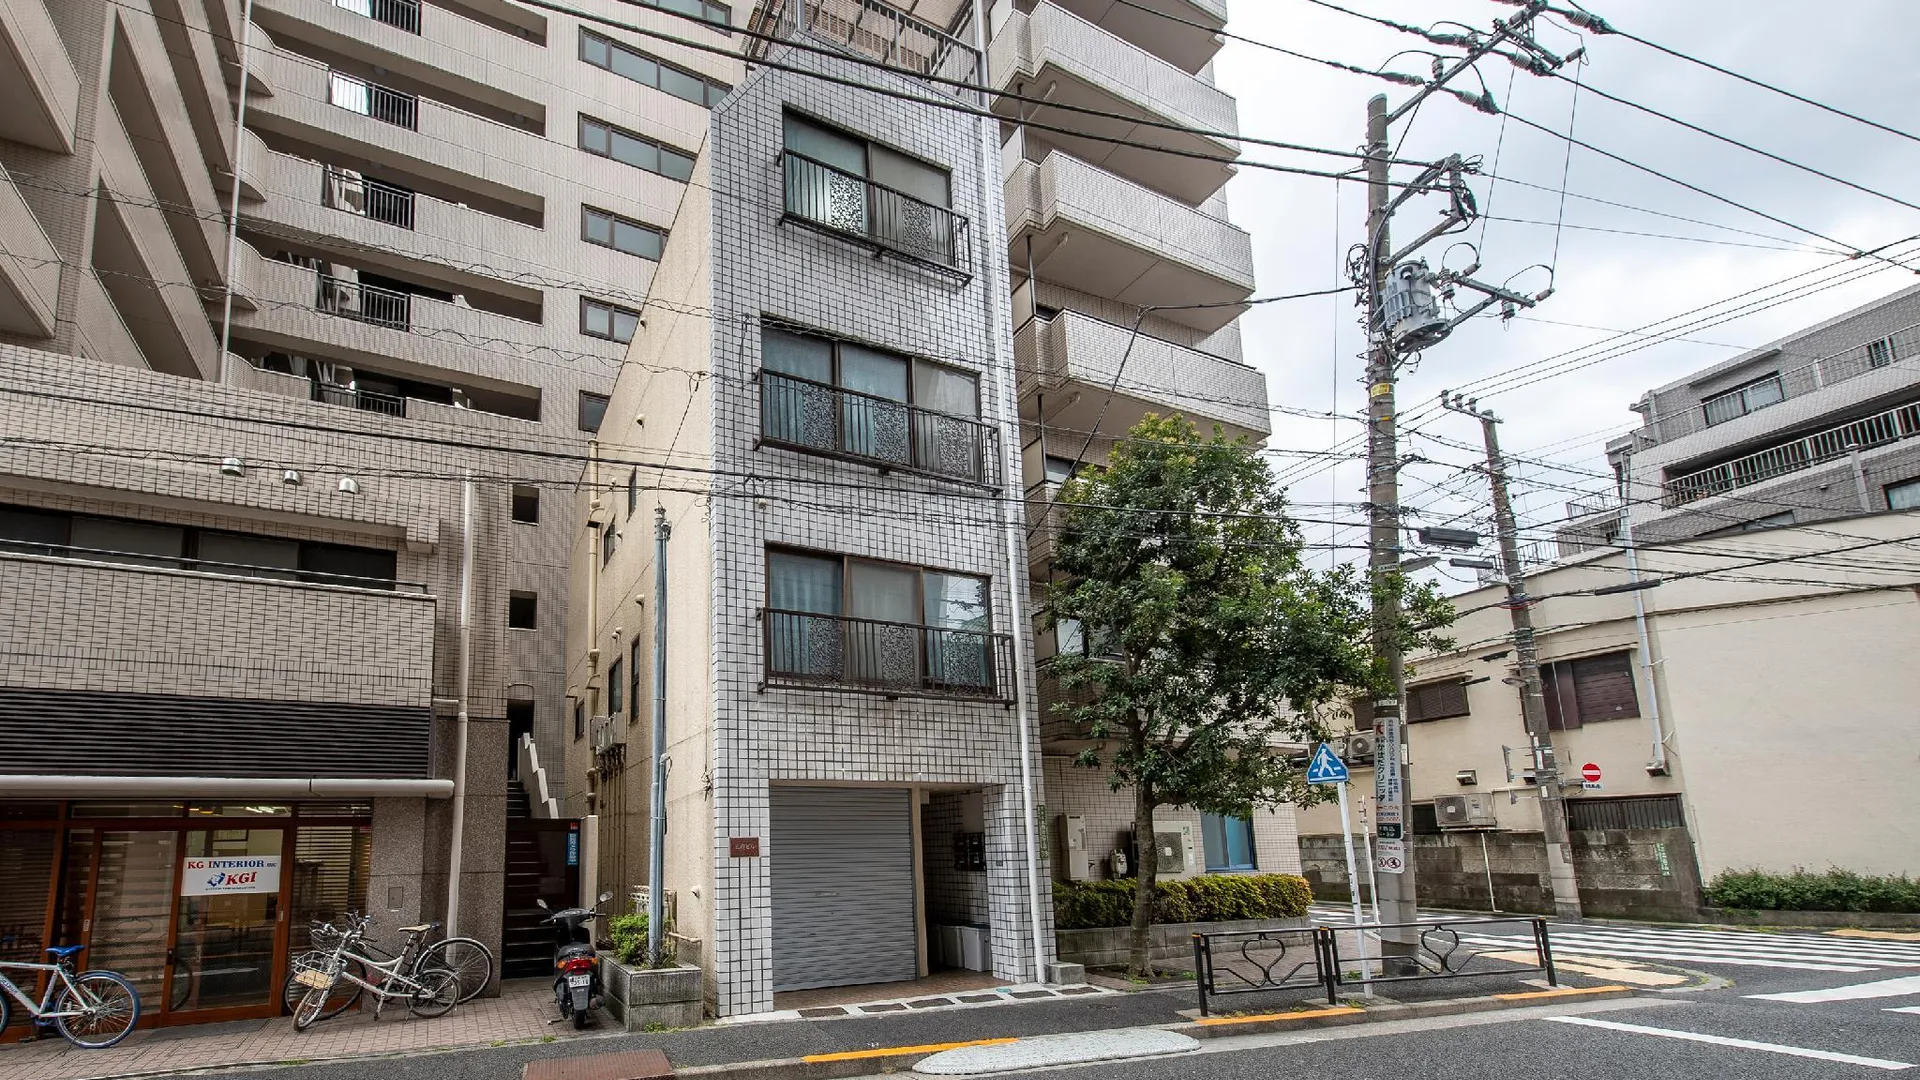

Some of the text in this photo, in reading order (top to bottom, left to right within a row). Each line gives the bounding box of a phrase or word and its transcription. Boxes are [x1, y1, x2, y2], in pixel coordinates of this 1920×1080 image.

[187, 861, 204, 869] KG
[208, 860, 264, 868] INTERIOR
[225, 872, 257, 886] KGI
